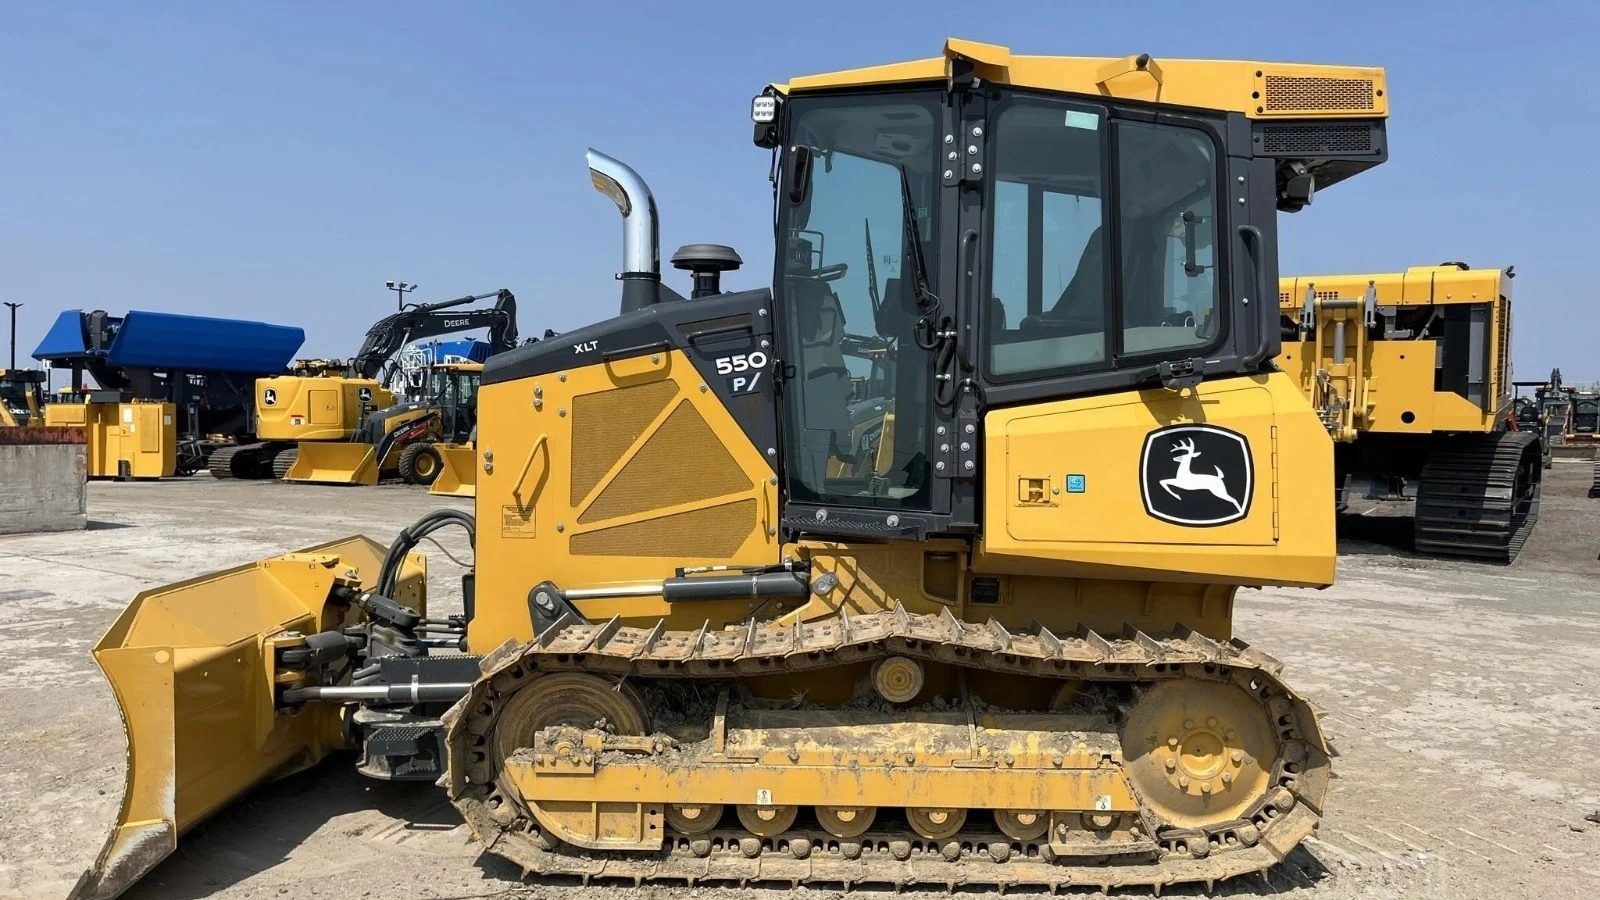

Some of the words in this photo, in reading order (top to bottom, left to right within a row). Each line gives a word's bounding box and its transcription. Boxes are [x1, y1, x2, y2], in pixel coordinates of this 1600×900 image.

[444, 318, 470, 328] DEERE
[573, 340, 599, 354] XLT
[715, 351, 767, 375] 550
